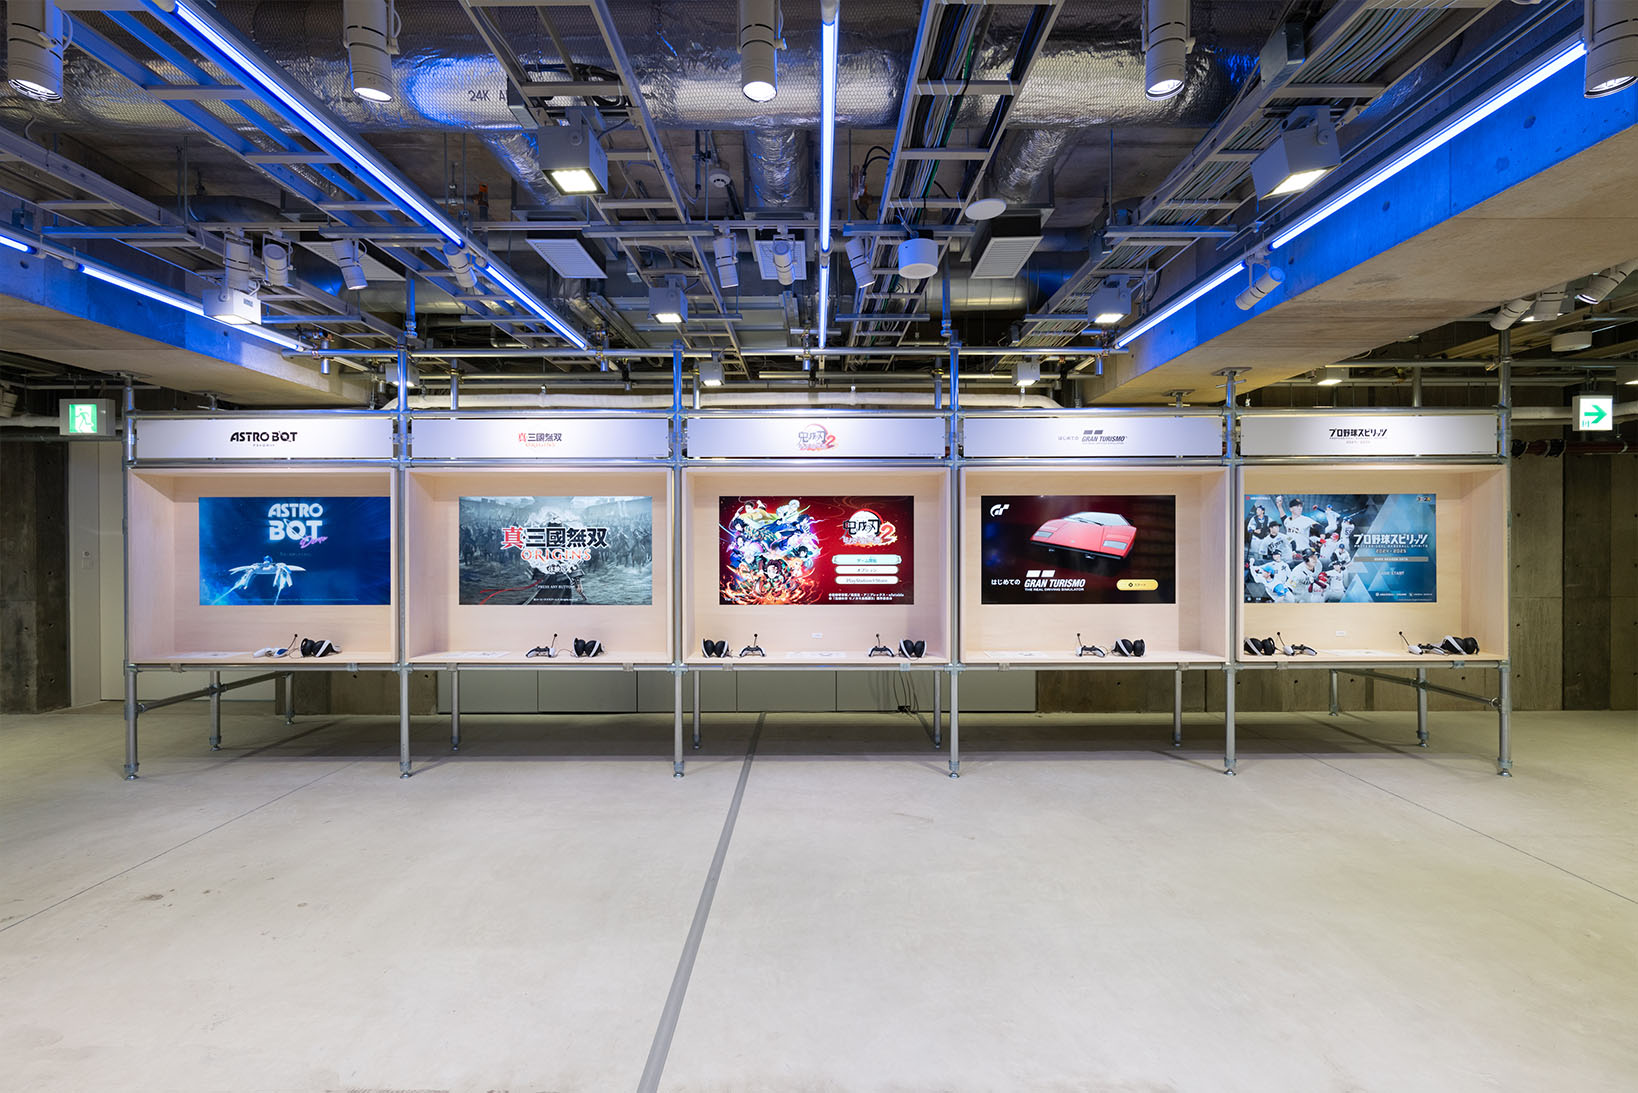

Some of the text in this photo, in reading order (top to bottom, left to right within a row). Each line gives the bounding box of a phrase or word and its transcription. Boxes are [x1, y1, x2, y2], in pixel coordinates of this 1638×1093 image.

[468, 89, 490, 102] 24K
[230, 430, 298, 442] ASTRO BOT
[268, 503, 324, 518] ASTRO
[269, 518, 323, 541] BOT
[880, 523, 895, 544] 2
[1353, 532, 1428, 545] プロ野球スピリッツ
[521, 549, 592, 562] ORIGINS
[1024, 579, 1048, 588] GRAN
[1049, 579, 1086, 588] TURISMO
